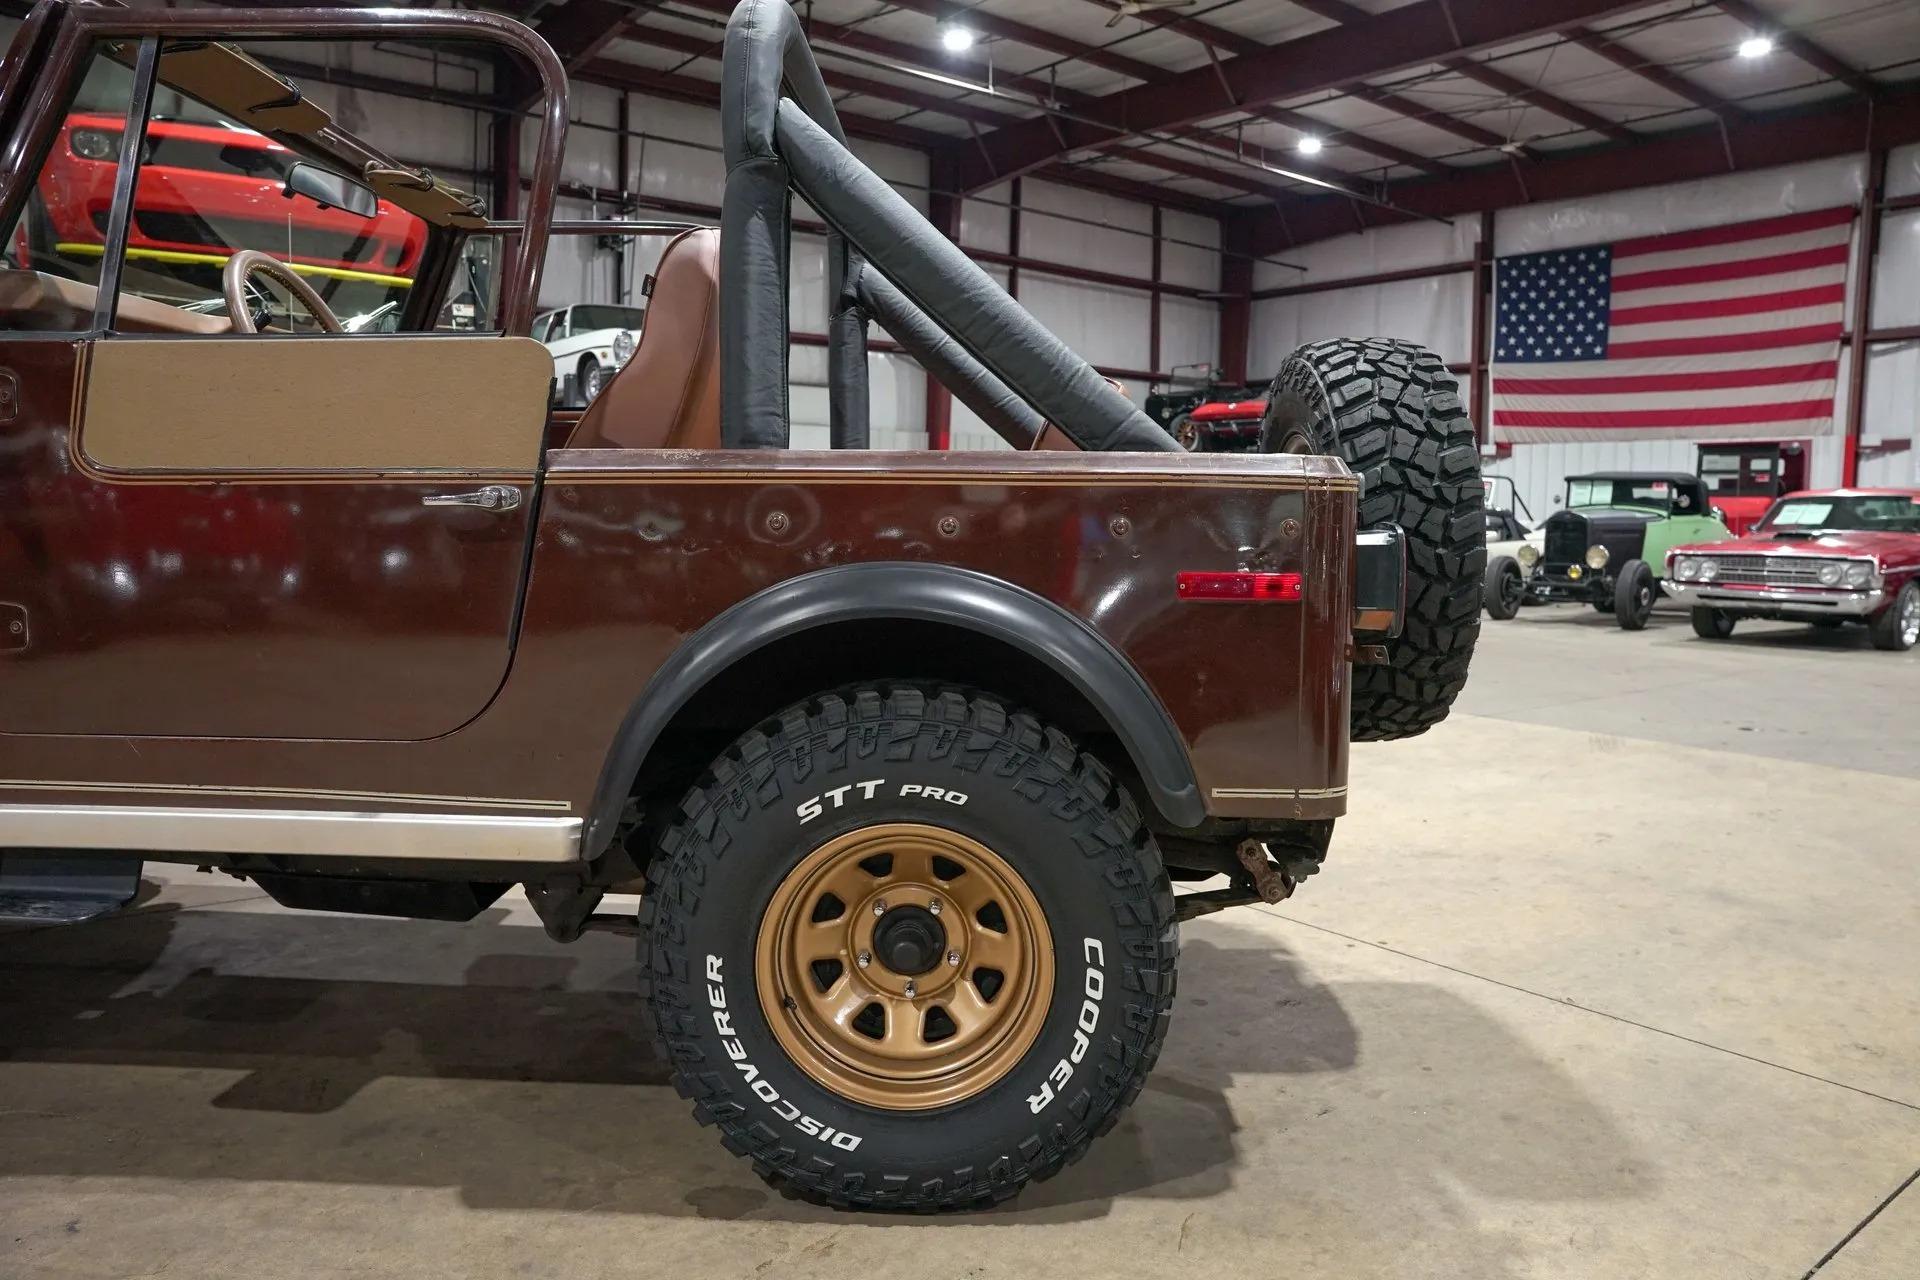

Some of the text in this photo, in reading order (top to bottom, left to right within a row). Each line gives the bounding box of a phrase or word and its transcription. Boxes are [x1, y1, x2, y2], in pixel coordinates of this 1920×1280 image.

[796, 778, 969, 826] STT PRO
[706, 954, 863, 1152] DISCOVERER
[1025, 937, 1105, 1115] COOPER
